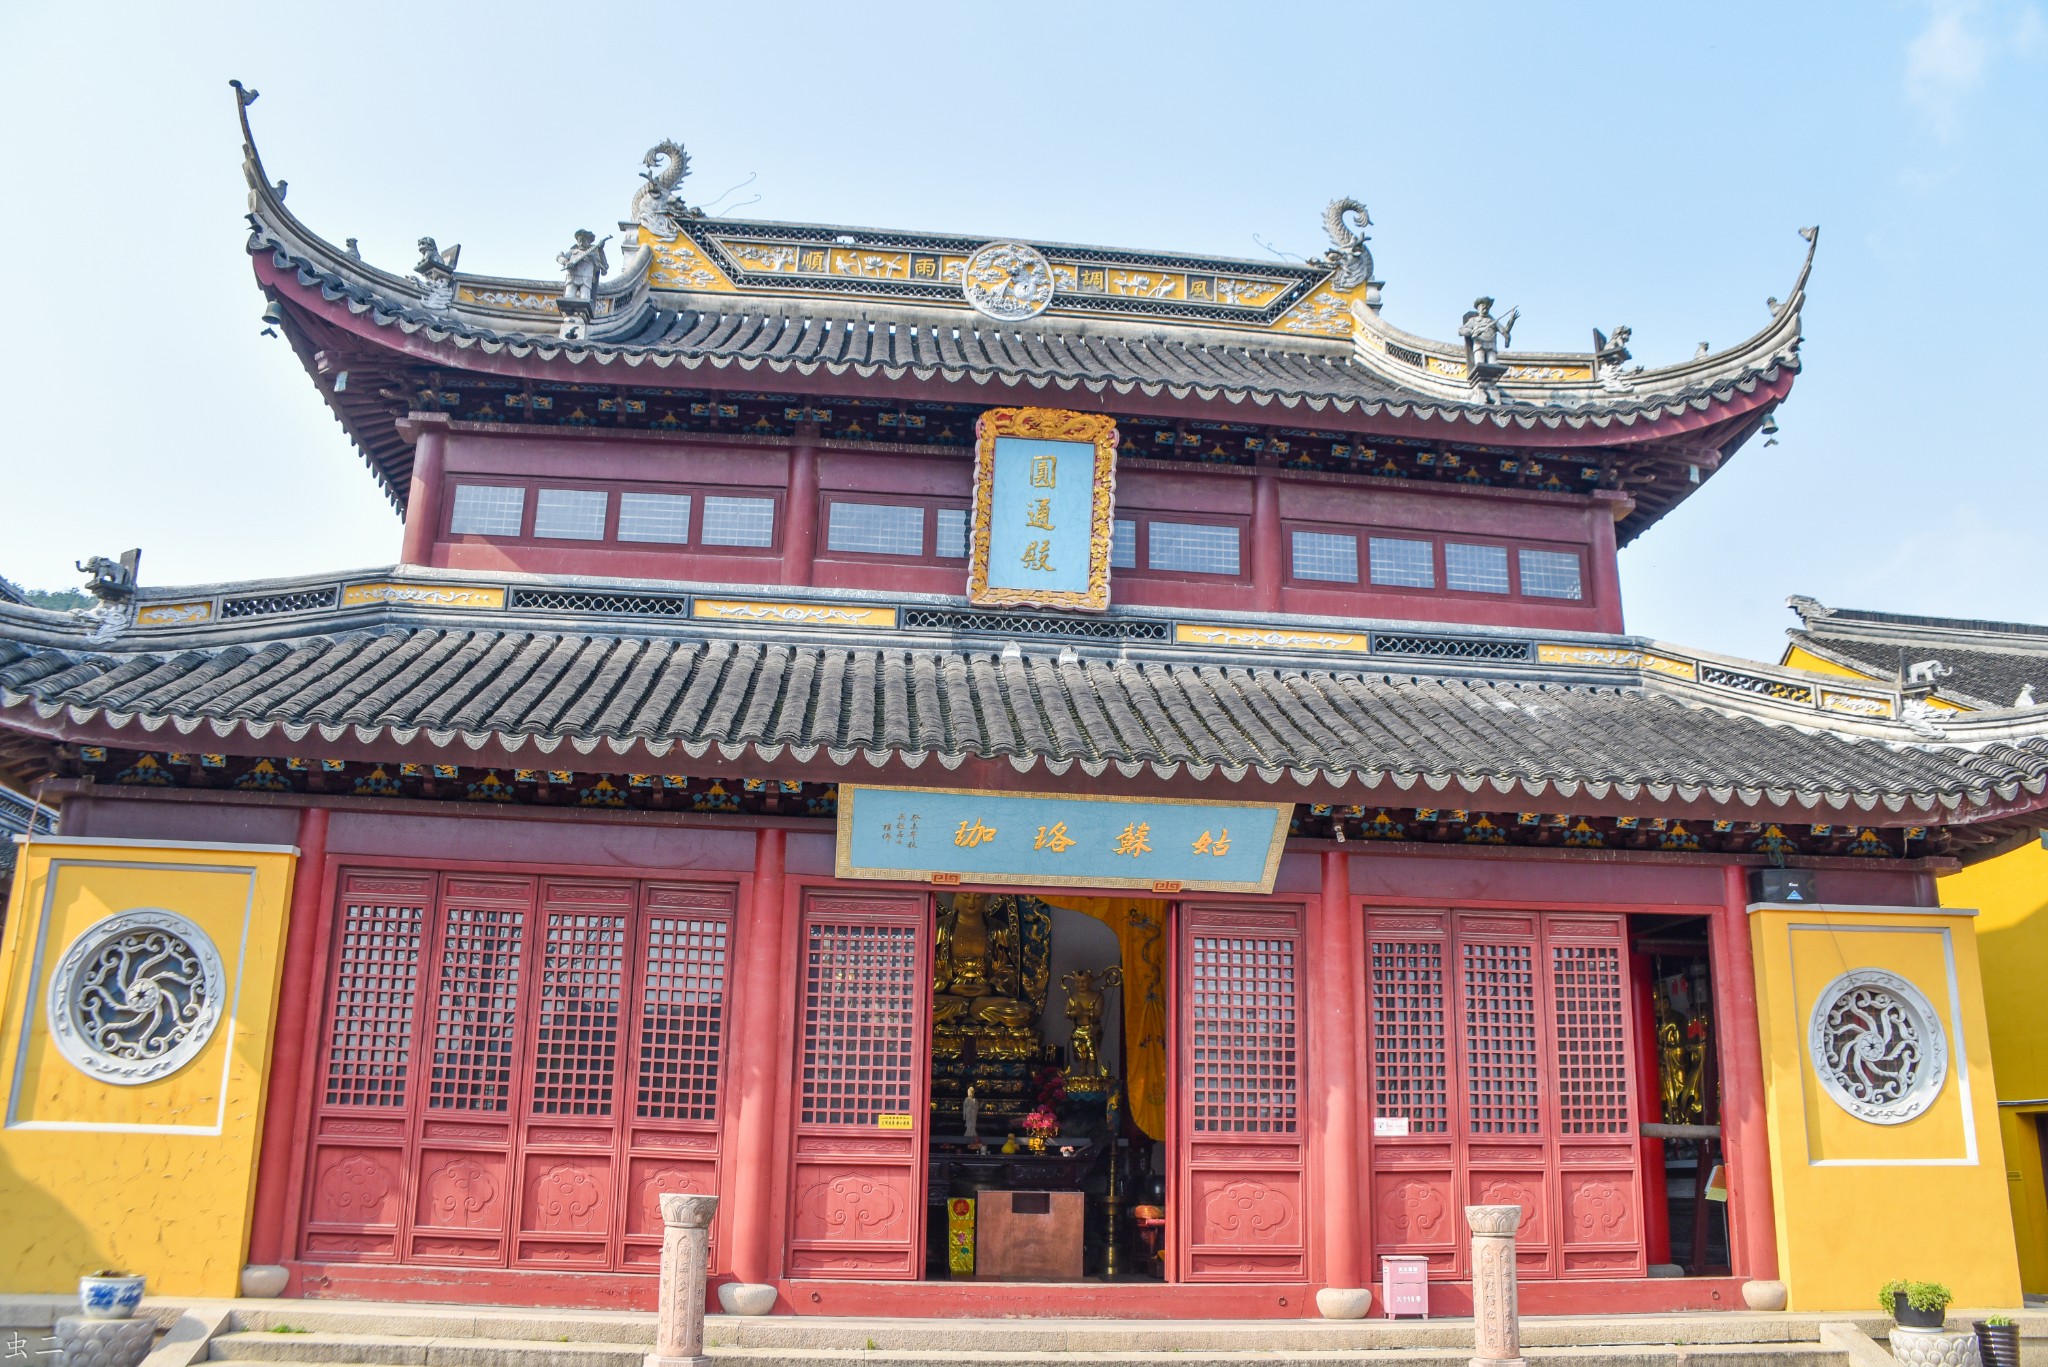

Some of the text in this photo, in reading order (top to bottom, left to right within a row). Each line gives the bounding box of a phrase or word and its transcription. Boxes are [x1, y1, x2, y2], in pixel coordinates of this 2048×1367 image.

[801, 250, 1212, 301] 風 調 雨 順
[1020, 455, 1058, 572] 圓通殿
